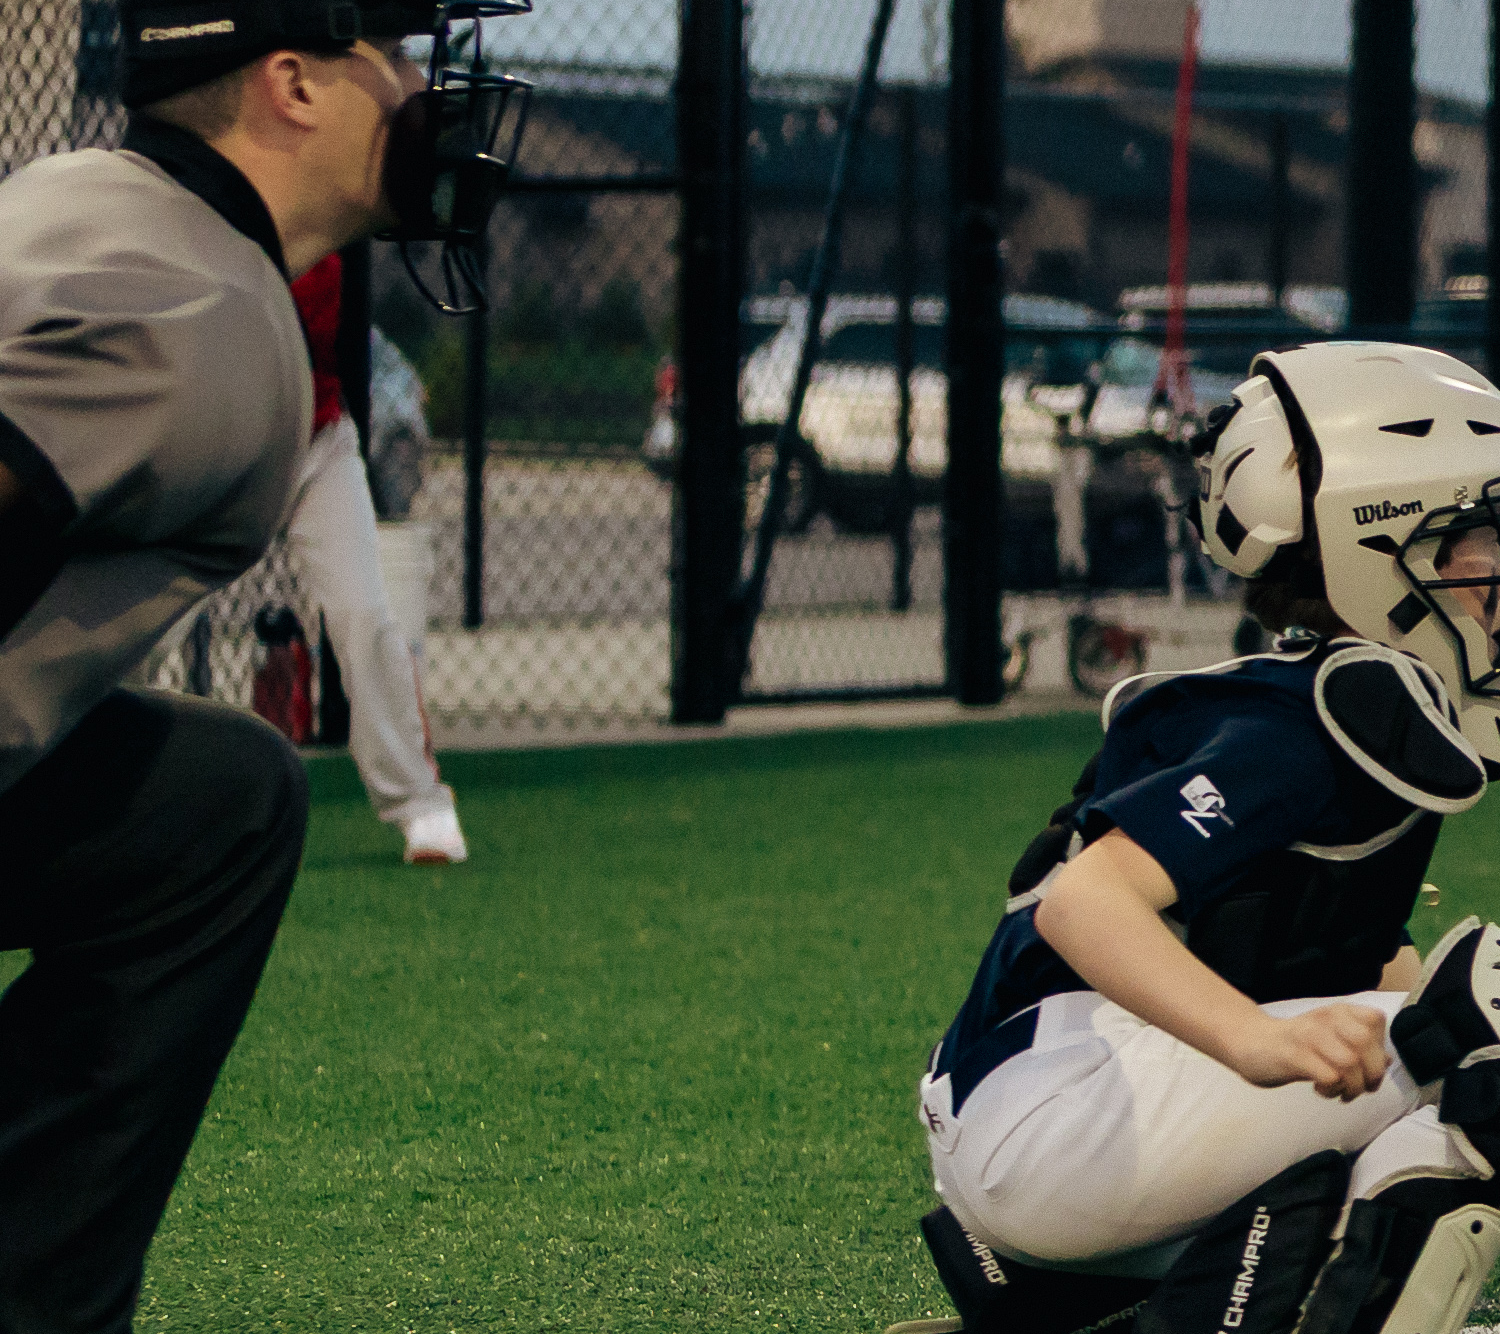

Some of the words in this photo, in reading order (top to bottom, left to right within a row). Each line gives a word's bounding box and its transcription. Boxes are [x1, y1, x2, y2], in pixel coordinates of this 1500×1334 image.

[1353, 499, 1424, 526] Wilson
[962, 1228, 1007, 1285] MPRO
[1223, 1213, 1271, 1328] CHAMPRO
